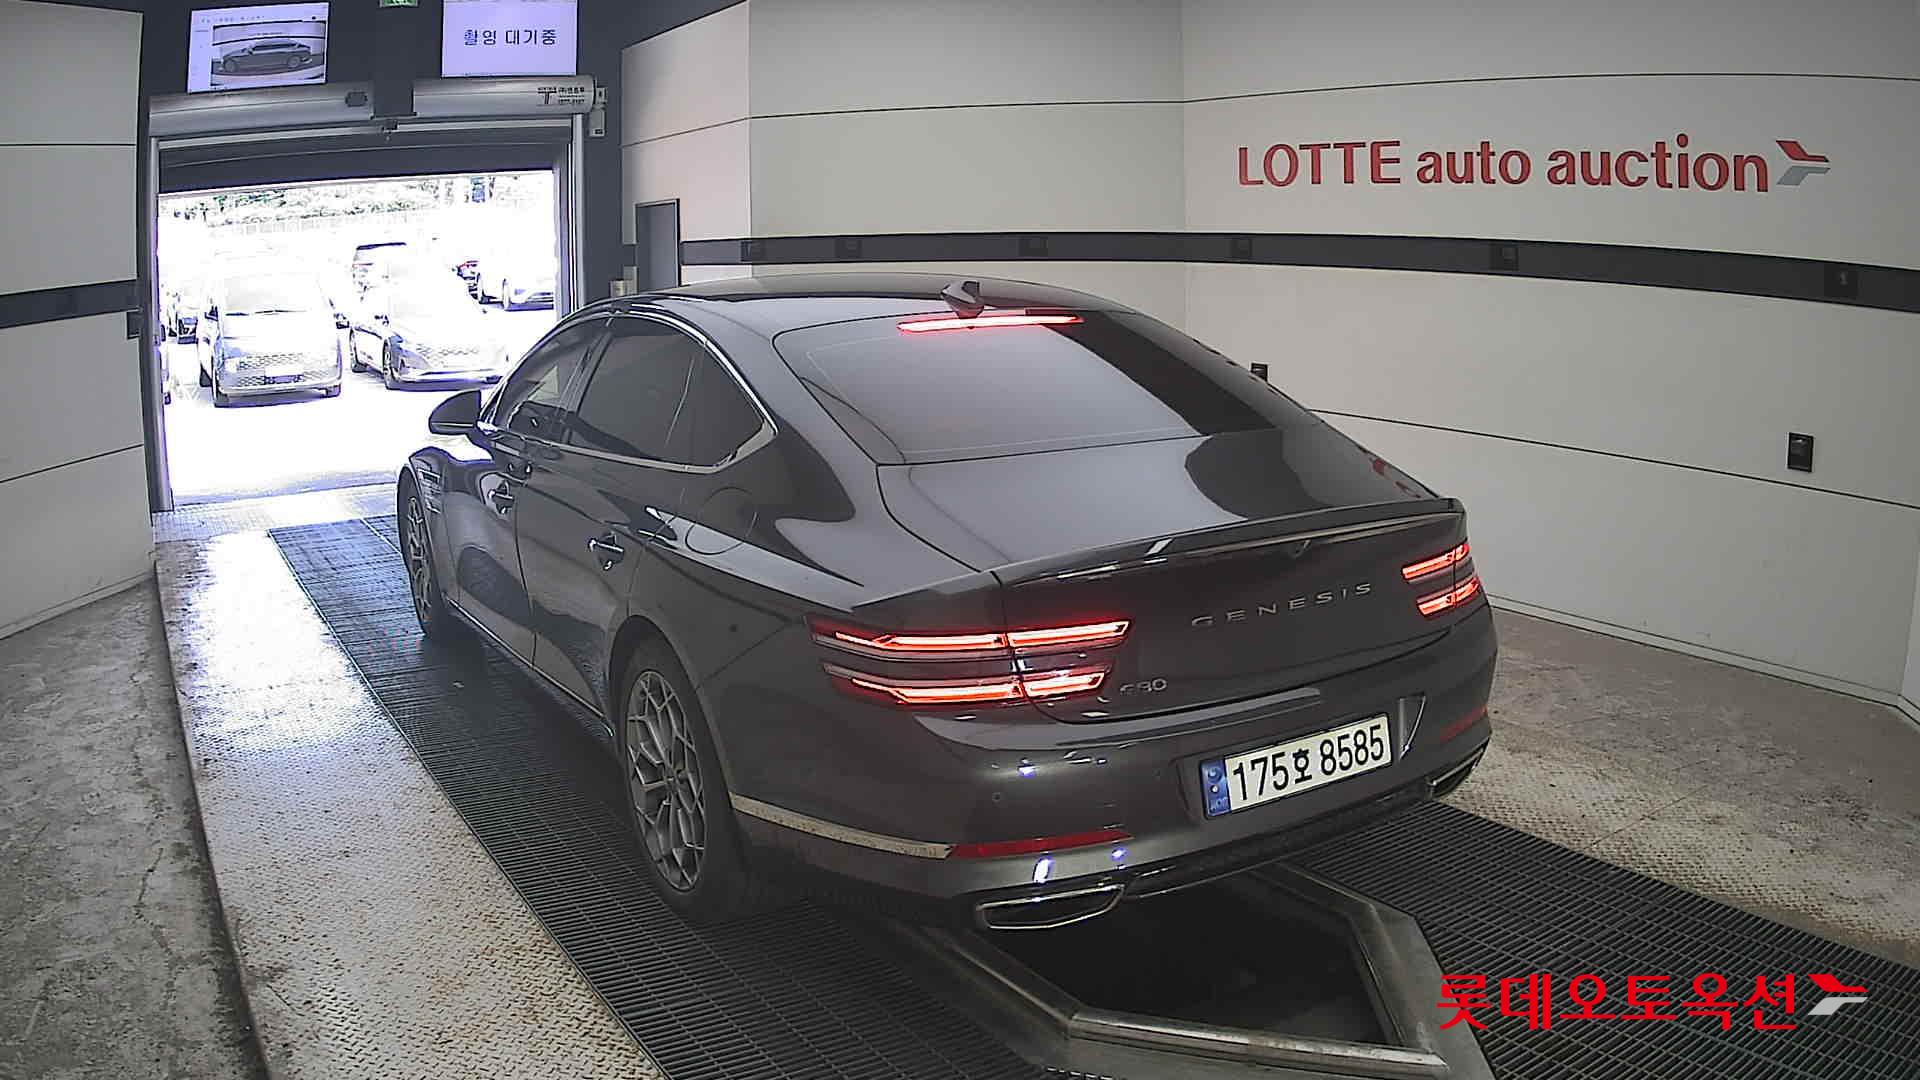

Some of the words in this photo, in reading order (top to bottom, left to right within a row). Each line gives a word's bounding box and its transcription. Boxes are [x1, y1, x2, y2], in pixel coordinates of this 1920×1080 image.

[505, 29, 557, 46] 대기중
[1238, 140, 1401, 187] LOTTE
[1416, 140, 1532, 186] auto
[1547, 133, 1769, 192] auction
[1191, 583, 1371, 627] GENESIS
[1233, 749, 1312, 800] 175호
[1319, 724, 1384, 776] 8585
